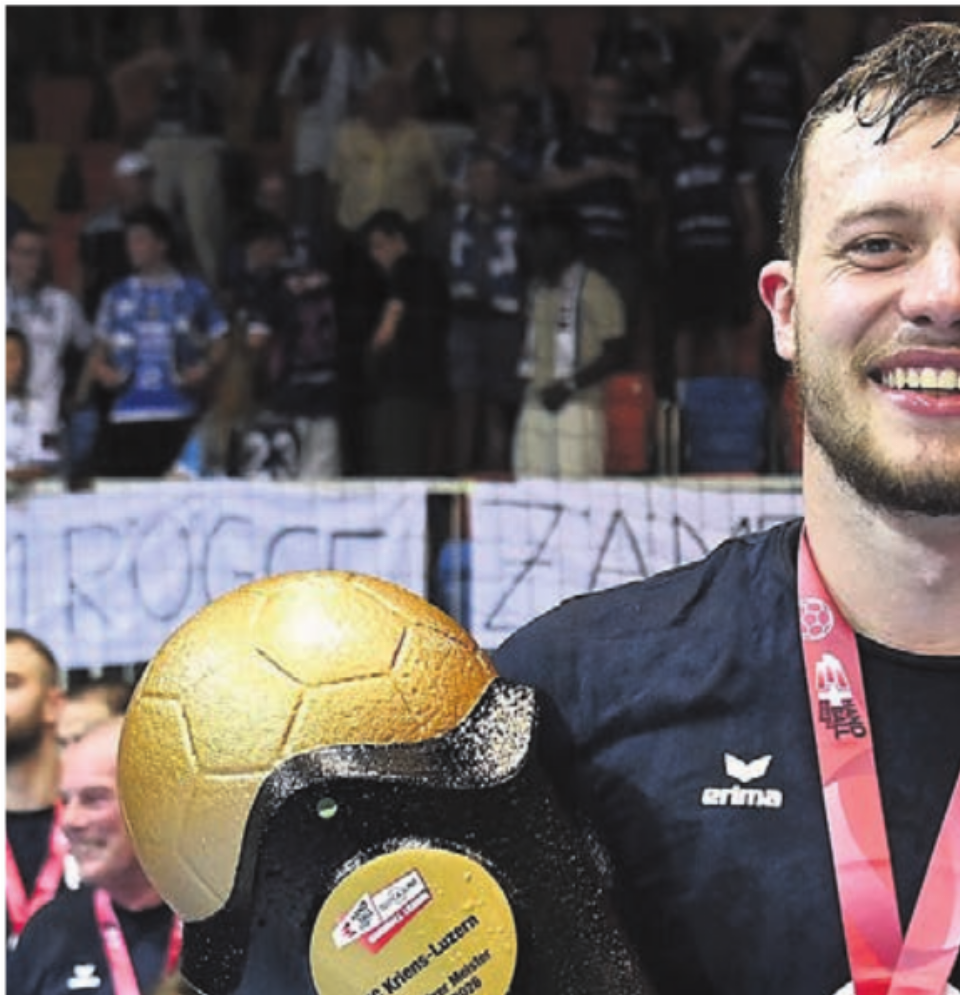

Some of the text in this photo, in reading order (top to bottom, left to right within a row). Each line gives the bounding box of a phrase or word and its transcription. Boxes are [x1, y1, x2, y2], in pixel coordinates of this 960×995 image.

[701, 784, 783, 809] erima
[381, 914, 480, 995] Kriens-Luzern
[449, 949, 491, 987] Meister
